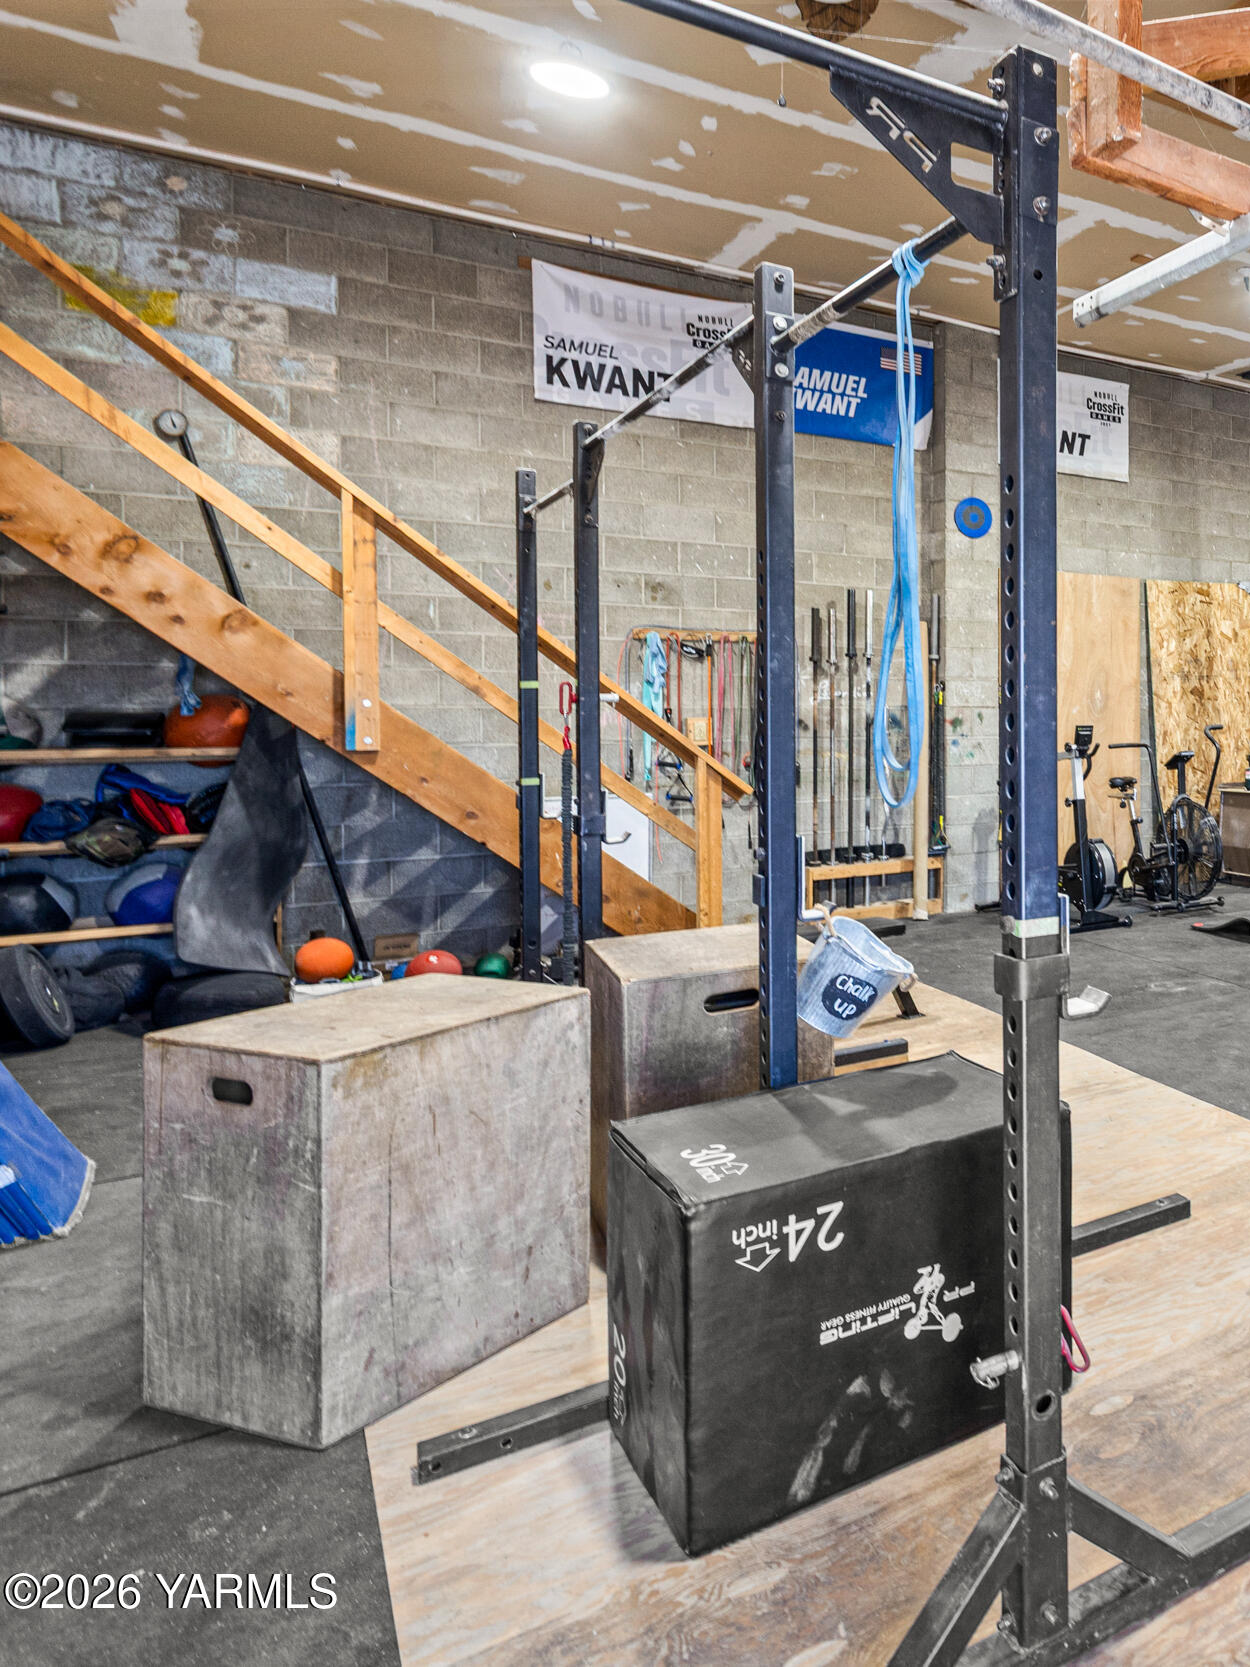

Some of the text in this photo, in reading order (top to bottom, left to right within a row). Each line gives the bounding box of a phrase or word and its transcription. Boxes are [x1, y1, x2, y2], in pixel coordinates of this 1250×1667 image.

[686, 322, 733, 341] Cross
[543, 335, 619, 360] SAMUEL
[793, 366, 868, 399] AMUEL
[794, 387, 862, 418] WANT
[1086, 397, 1125, 416] CrossFit
[835, 975, 875, 1002] Chalk
[680, 1143, 736, 1168] 30
[732, 1201, 845, 1262] 24 inch
[877, 1293, 911, 1312] QUALITY
[820, 1315, 844, 1331] GEAR
[613, 1322, 626, 1387] 20
